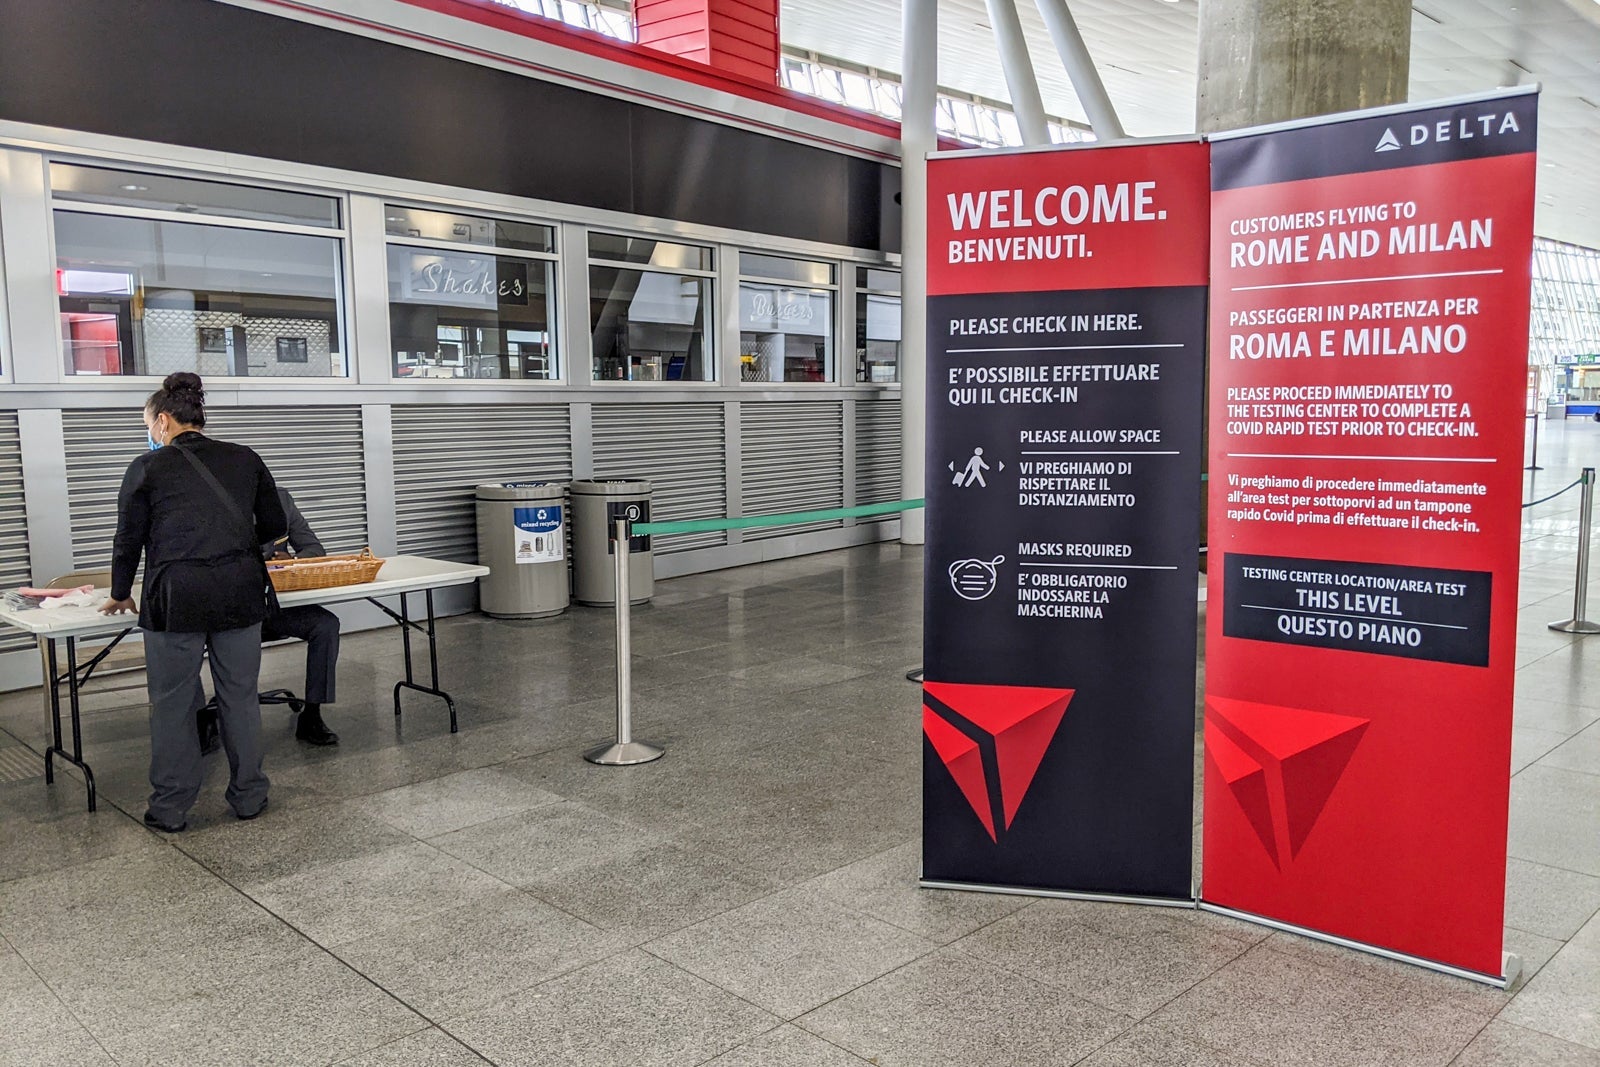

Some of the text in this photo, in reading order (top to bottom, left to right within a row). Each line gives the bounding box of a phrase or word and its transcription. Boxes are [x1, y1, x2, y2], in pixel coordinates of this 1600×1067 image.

[1410, 112, 1519, 146] DELTA
[947, 181, 1167, 230] WELCOME.
[1230, 201, 1416, 236] CUSTOMERS FLYING TO
[948, 234, 1093, 264] BENVENUTI.
[1230, 218, 1493, 268] ROME AND MILAN
[418, 263, 523, 296] Shakes
[1229, 298, 1479, 326] PASSEGGERI IN PARTENZA PER
[950, 314, 1142, 336] PLEASE CHECK IN HERE.
[1229, 324, 1466, 359] ROMA E MILANO
[949, 364, 1160, 383] E' POSSIBILE EFFETTUARE
[949, 387, 1078, 406] QUI IL CHECK-IN
[1227, 384, 1452, 400] PLEASE PROCEED IMMEDIATELY TO
[1227, 403, 1471, 418] THE TESTING CENTER TO COMPLETE A
[1020, 430, 1161, 443] PLEASE ALLOW SPACE
[1227, 422, 1479, 436] COVID RAPID TEST PRIOR TO CHECK-IN.
[1019, 462, 1132, 475] VI PREGHIAMO DI
[1019, 478, 1111, 490] RISPETTARE IL
[1228, 474, 1487, 496] Vi preghiamo di procedere immediatamente
[1019, 493, 1135, 506] DISTANZIAMENTO
[1227, 491, 1472, 515] all'area test per sottoporvi ad un tampone
[1227, 509, 1480, 533] rapido Covid prima di effettuare il check-in.
[1018, 543, 1132, 557] MASKS REQUIRED
[1018, 574, 1127, 588] E' OBBLIGATORIO
[1242, 567, 1466, 596] TESTING CENTER LOCATION/AREA TEST
[1018, 589, 1109, 603] INDOSSARE LA
[1296, 589, 1402, 616] THIS LEVEL
[1017, 604, 1103, 619] MASCHERINA
[1277, 615, 1421, 647] QUESTO PIANO
